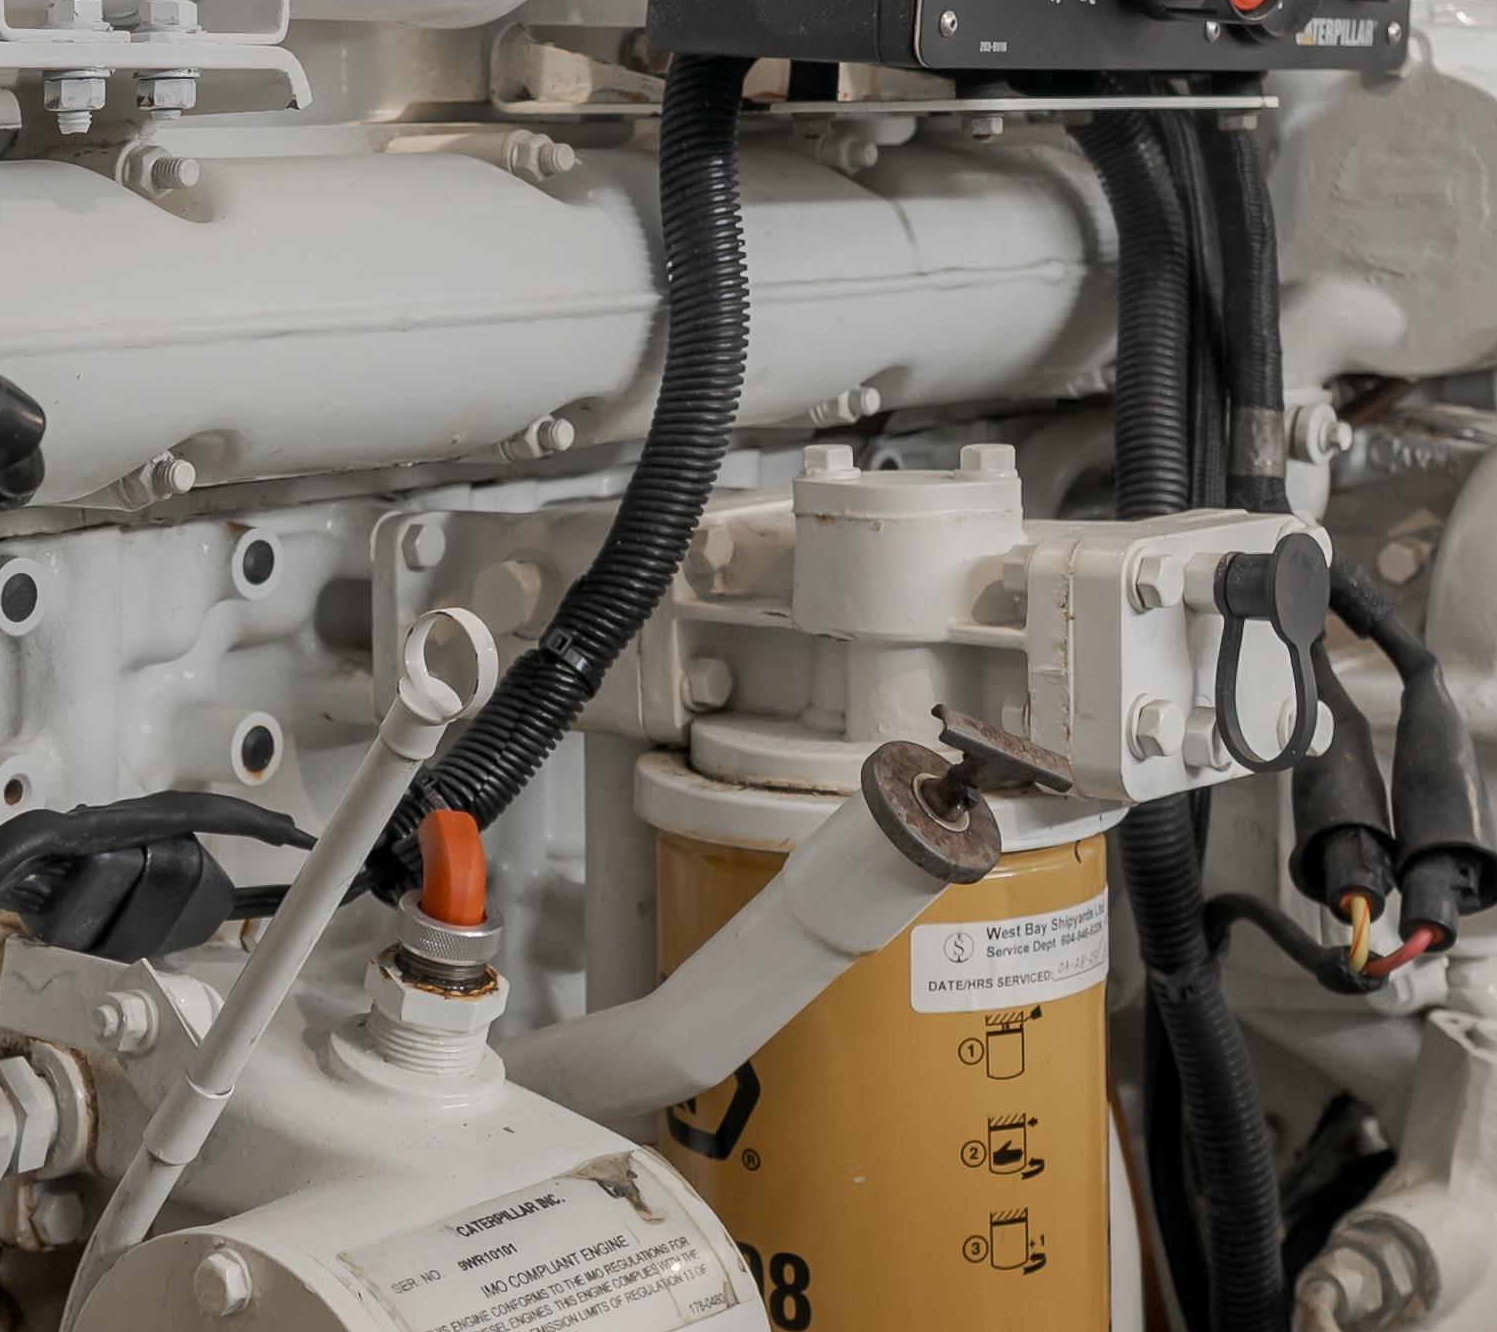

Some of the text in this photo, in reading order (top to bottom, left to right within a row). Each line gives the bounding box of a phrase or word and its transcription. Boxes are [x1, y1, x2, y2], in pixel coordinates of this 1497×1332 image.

[987, 927, 1021, 940] West
[1025, 923, 1047, 937] Bay
[1052, 909, 1093, 931] Shipyards
[987, 944, 1029, 958] Service
[1033, 940, 1056, 953] Dept
[928, 971, 1053, 992] DATE/HRS SERVICED:
[456, 1194, 565, 1237] CATERPILLAR INC.
[421, 1269, 444, 1285] NO.
[457, 1243, 517, 1271] 9WR10101
[451, 1310, 489, 1332] ENGINE
[492, 1290, 549, 1317] CONFORMS
[549, 1282, 563, 1296] TO
[563, 1276, 583, 1292] THE
[584, 1269, 603, 1283] IMO
[604, 1247, 667, 1276] REGULATIONS
[668, 1236, 689, 1252] FOR
[480, 1235, 629, 1298] IMO COMPLIANT ENGINE
[554, 1297, 576, 1313] THIS
[577, 1283, 612, 1305] ENGINE
[612, 1265, 657, 1292] COMPLIES
[680, 1249, 700, 1264] THE
[579, 1301, 610, 1321] LIMITS
[610, 1295, 623, 1309] OF
[625, 1276, 683, 1303] REGULATION
[683, 1269, 695, 1281] 13
[695, 1263, 707, 1277] OF
